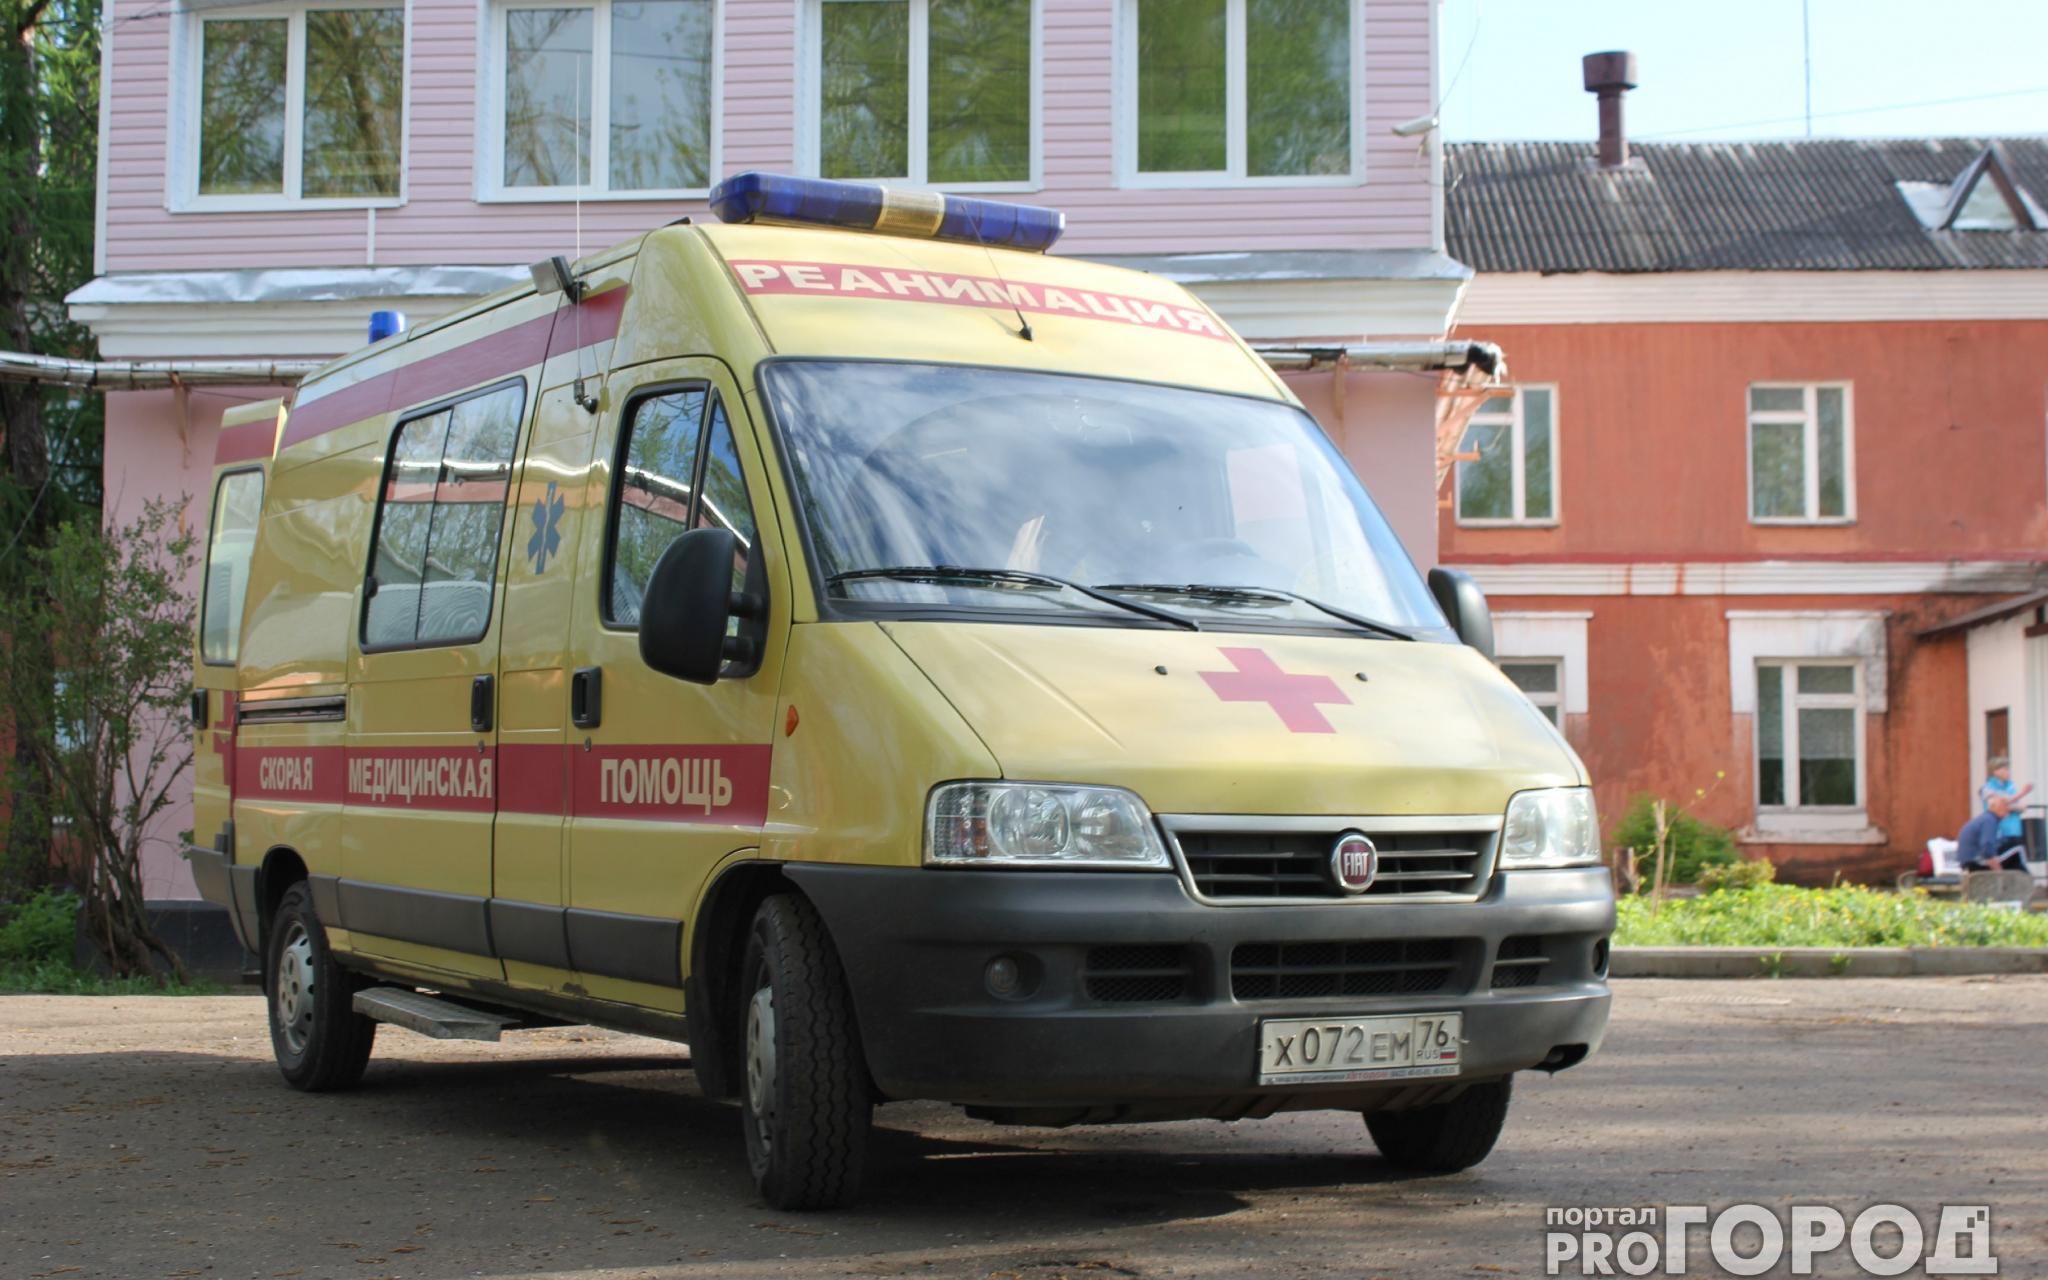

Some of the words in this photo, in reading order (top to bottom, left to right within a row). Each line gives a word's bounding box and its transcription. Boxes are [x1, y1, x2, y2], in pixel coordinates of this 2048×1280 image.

[734, 264, 1223, 337] РЕАНИМАЦИЯ
[260, 756, 313, 791] СКОРАЯ
[348, 757, 493, 803] МЕДИЦИНСКАЯ
[600, 757, 733, 815] ПОМОЩЬ
[1343, 852, 1369, 876] FIAT
[1417, 1020, 1449, 1048] 76
[1416, 1049, 1439, 1061] RUS
